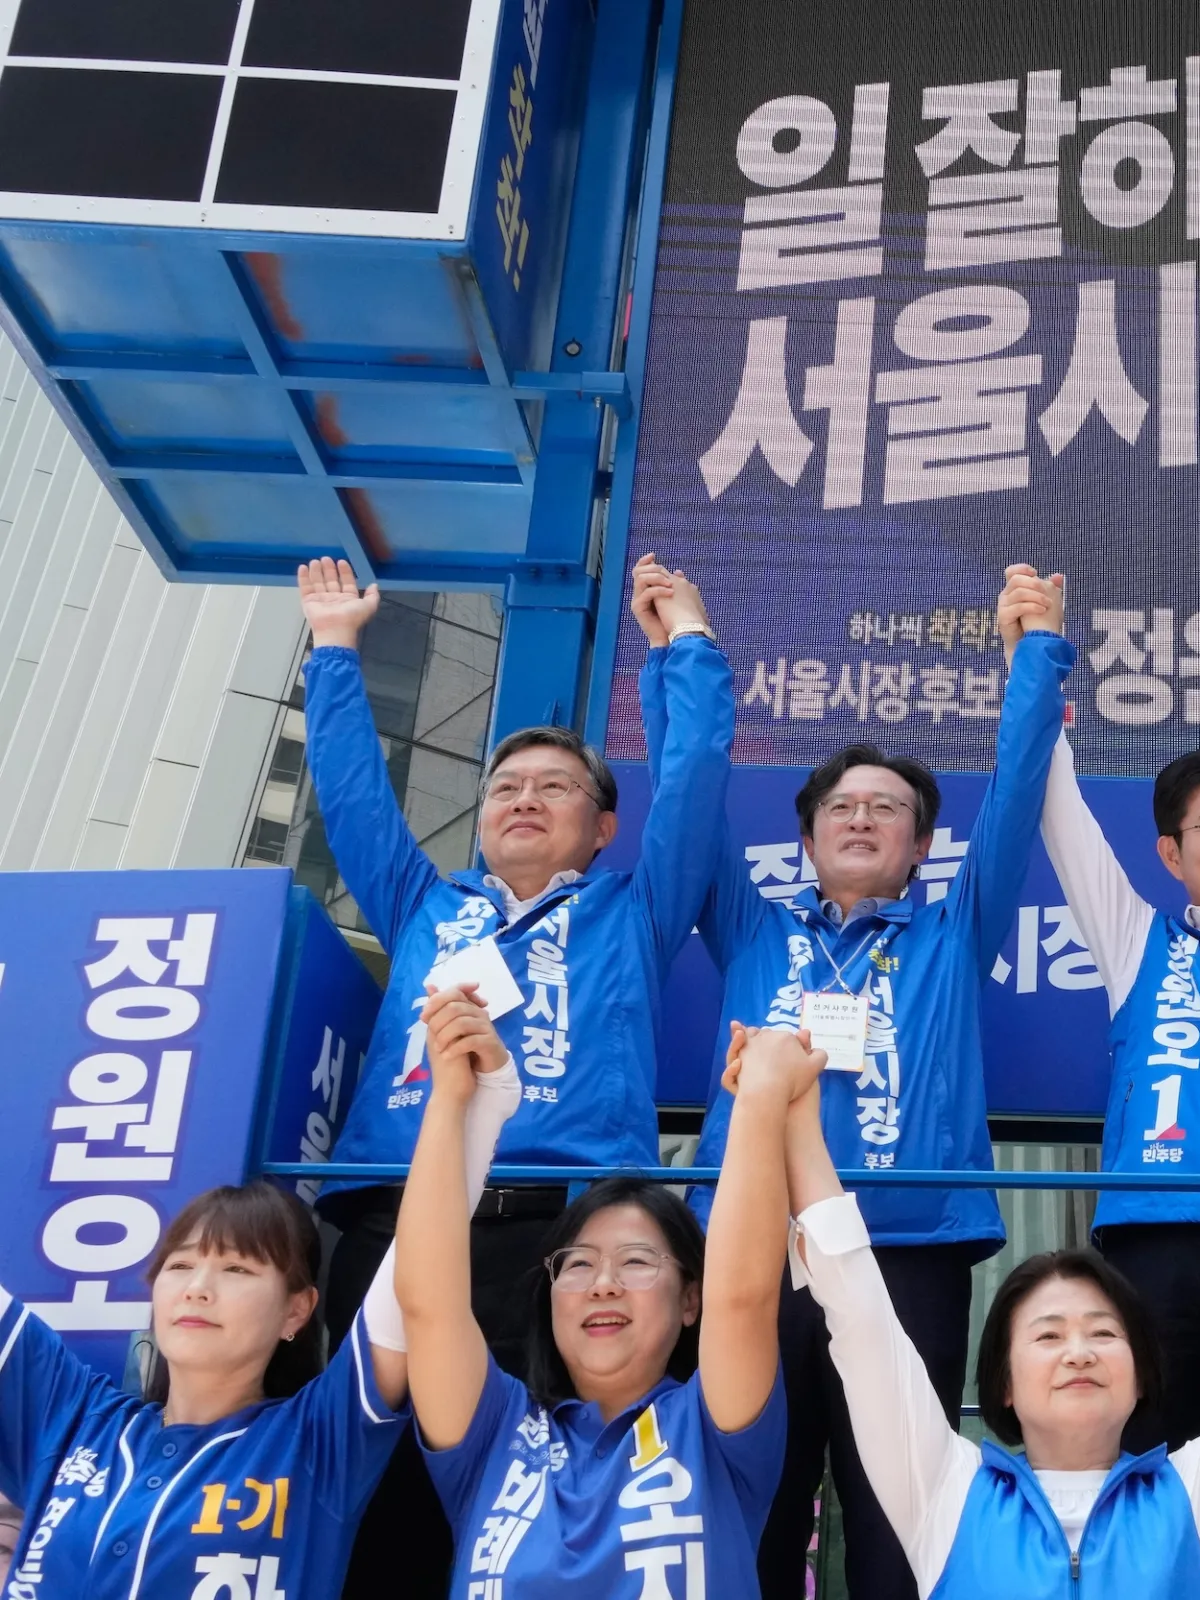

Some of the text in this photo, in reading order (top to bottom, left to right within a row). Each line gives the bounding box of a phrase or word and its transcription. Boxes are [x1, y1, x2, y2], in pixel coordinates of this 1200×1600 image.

[735, 81, 891, 292] 일
[850, 612, 923, 646] 하나씩
[521, 907, 571, 1078] 서울시장
[856, 970, 901, 1145] 서울시장
[30, 912, 217, 1331] 정원오
[523, 1085, 560, 1103] 후보
[864, 1152, 895, 1170] 후보
